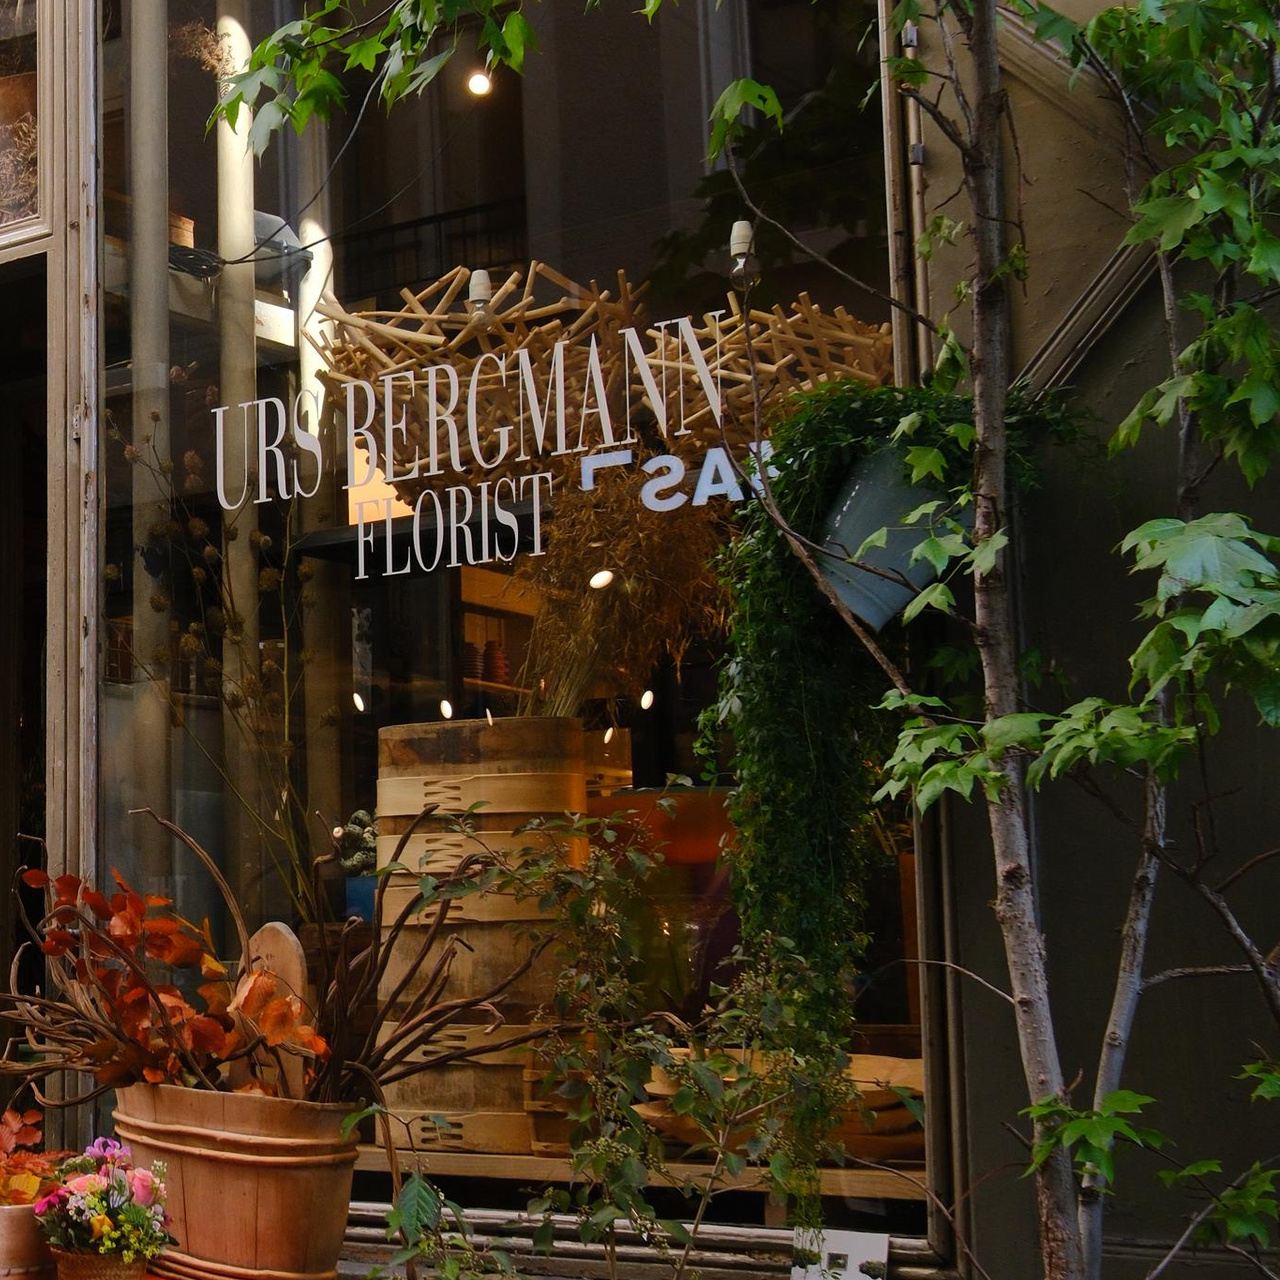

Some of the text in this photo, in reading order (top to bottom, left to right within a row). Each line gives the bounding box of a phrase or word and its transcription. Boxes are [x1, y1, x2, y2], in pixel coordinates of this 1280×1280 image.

[211, 308, 727, 511] URS BERGMANN
[354, 470, 554, 581] FLORIST
